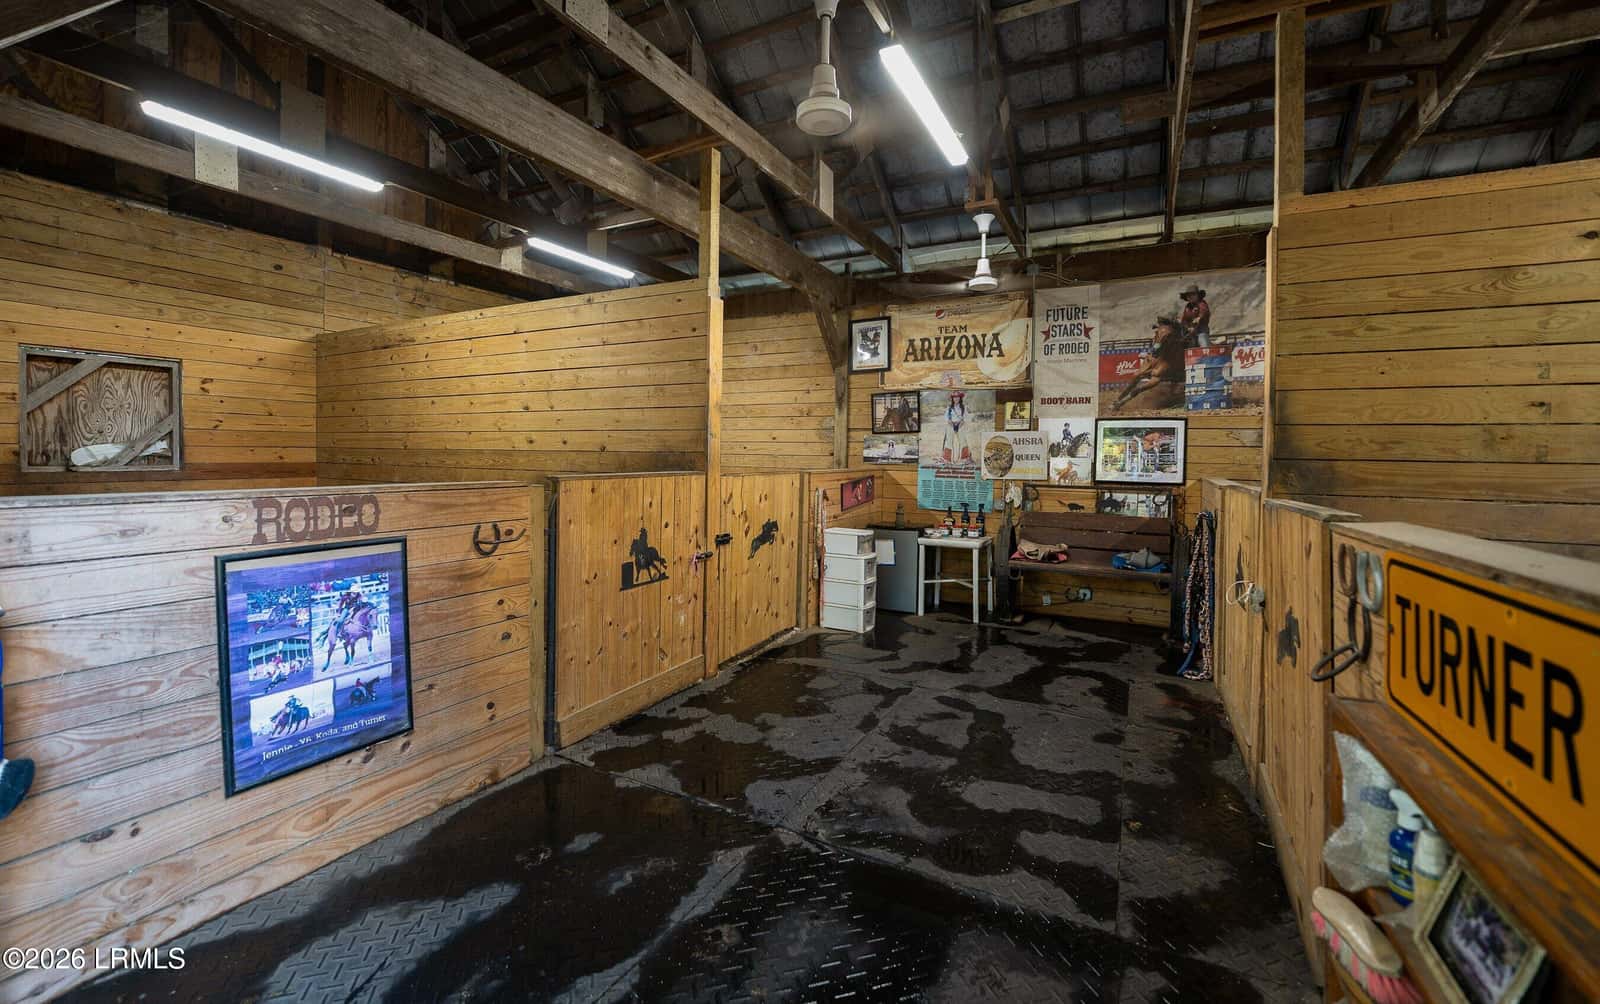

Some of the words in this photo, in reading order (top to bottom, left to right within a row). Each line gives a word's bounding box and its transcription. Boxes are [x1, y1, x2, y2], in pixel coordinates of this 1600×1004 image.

[1046, 306, 1088, 322] FUTURE
[938, 325, 967, 335] TEAM
[1051, 323, 1083, 338] STARS
[903, 333, 1005, 362] ARIZONA
[1043, 344, 1056, 356] OF
[1058, 342, 1090, 355] RODEO
[1040, 397, 1065, 405] BOOT
[1065, 397, 1091, 405] BARN
[1015, 453, 1041, 461] QUEEN
[251, 494, 380, 545] RODEO
[1395, 594, 1584, 806] TURNER
